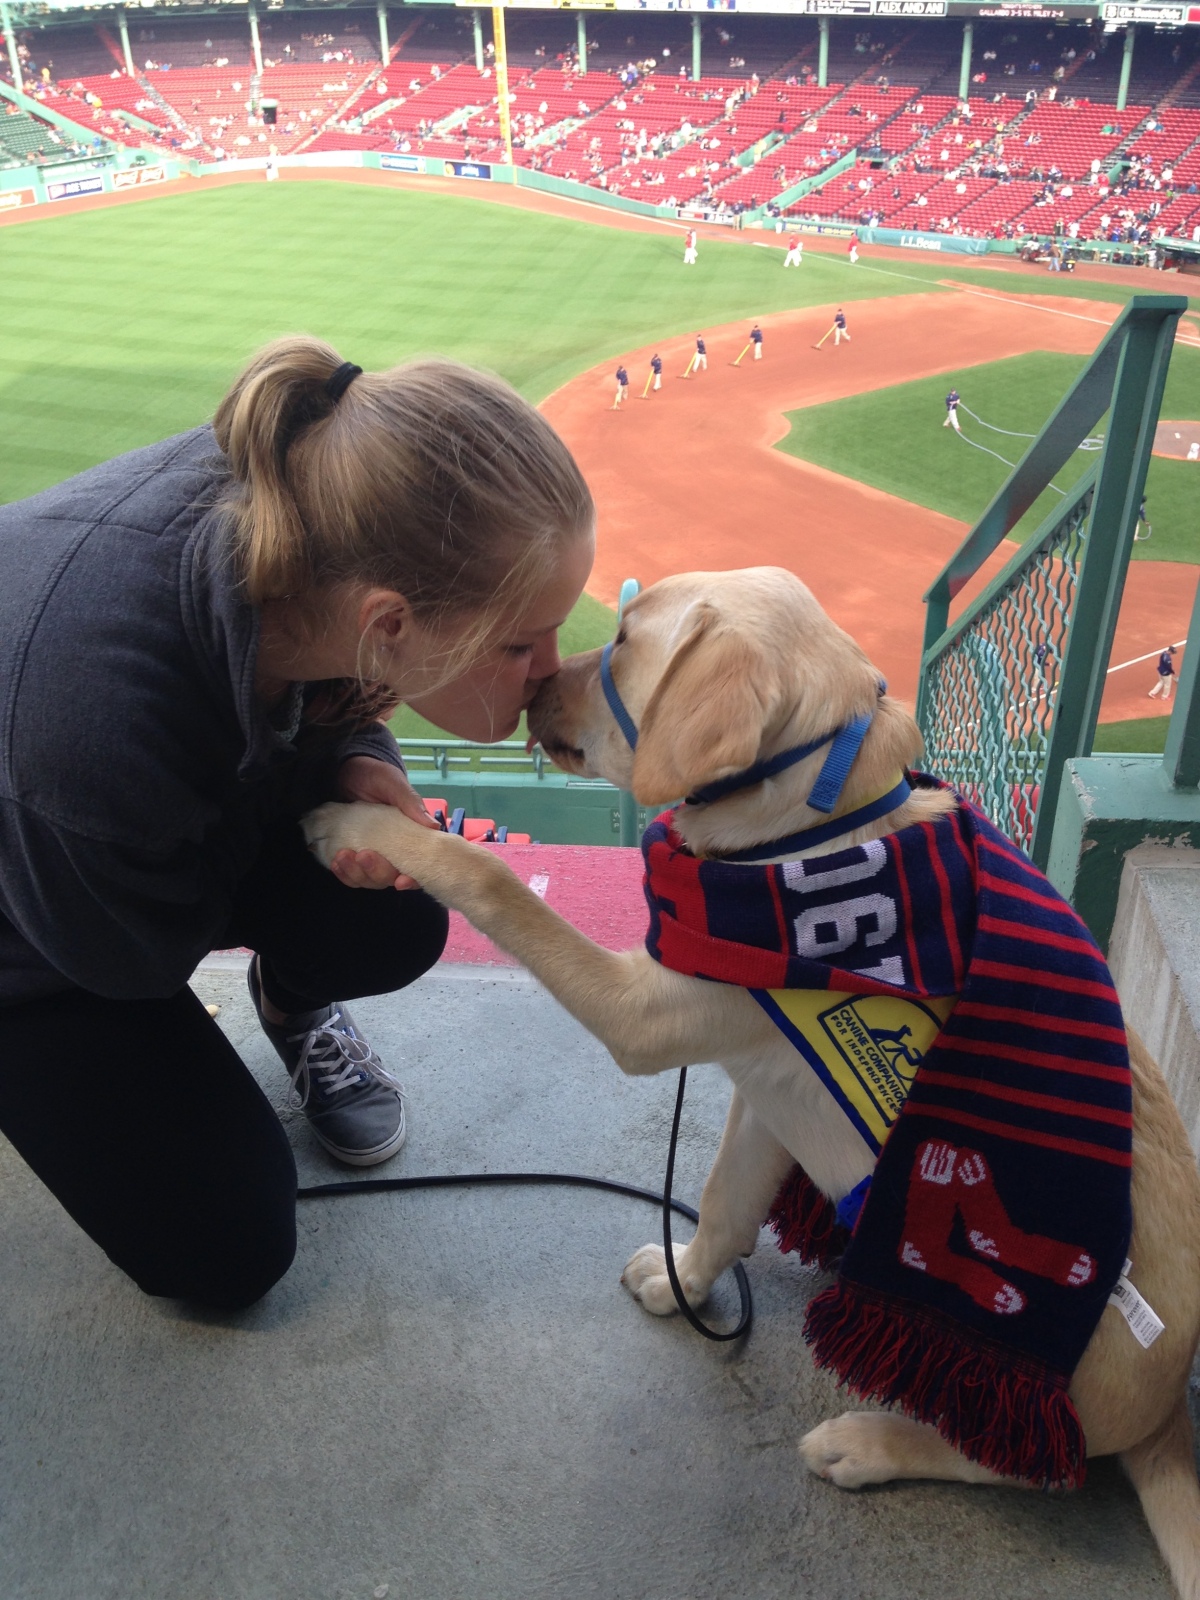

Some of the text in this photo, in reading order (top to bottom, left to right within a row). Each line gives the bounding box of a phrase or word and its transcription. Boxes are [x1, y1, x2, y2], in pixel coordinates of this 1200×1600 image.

[877, 1, 945, 14] ALEX AND ANI
[840, 1008, 869, 1047] CANINE
[830, 1014, 897, 1111] FOR INDEPENDENCE
